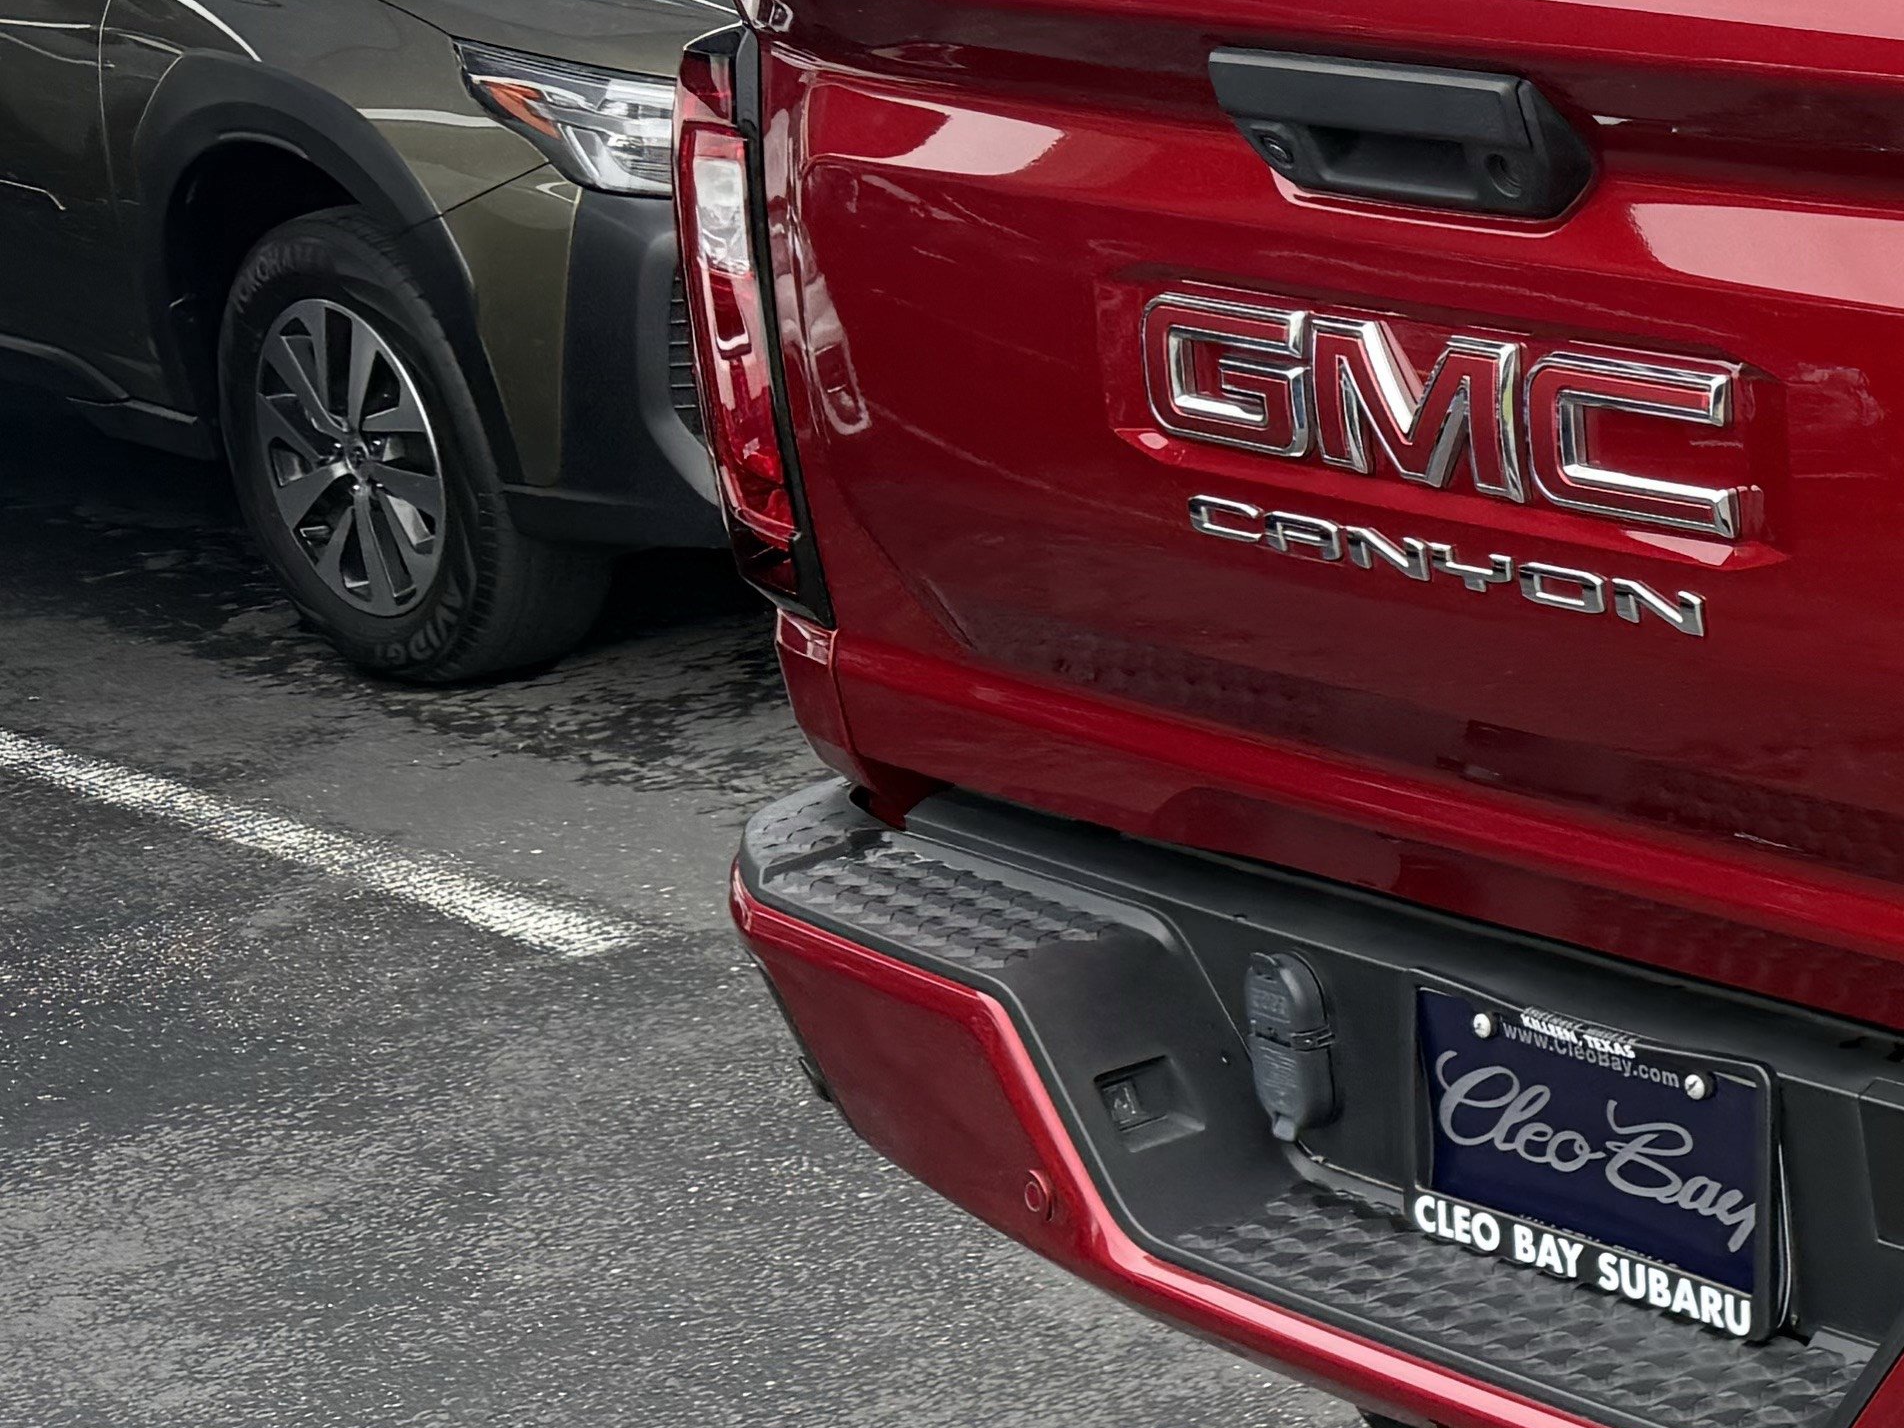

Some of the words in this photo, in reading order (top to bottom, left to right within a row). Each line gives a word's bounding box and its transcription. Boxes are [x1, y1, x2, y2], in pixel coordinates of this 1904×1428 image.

[1141, 291, 1742, 540] GMC
[1188, 493, 1707, 638] CANYON
[1502, 1022, 1680, 1089] www.CleoBay.com
[1583, 1033, 1636, 1059] TEXAS
[1436, 1050, 1607, 1172] Cleo
[1604, 1099, 1757, 1253] Bay
[1413, 1194, 1500, 1252] CLEO
[1512, 1224, 1584, 1278] BAY
[1598, 1252, 1752, 1336] SUBARU
